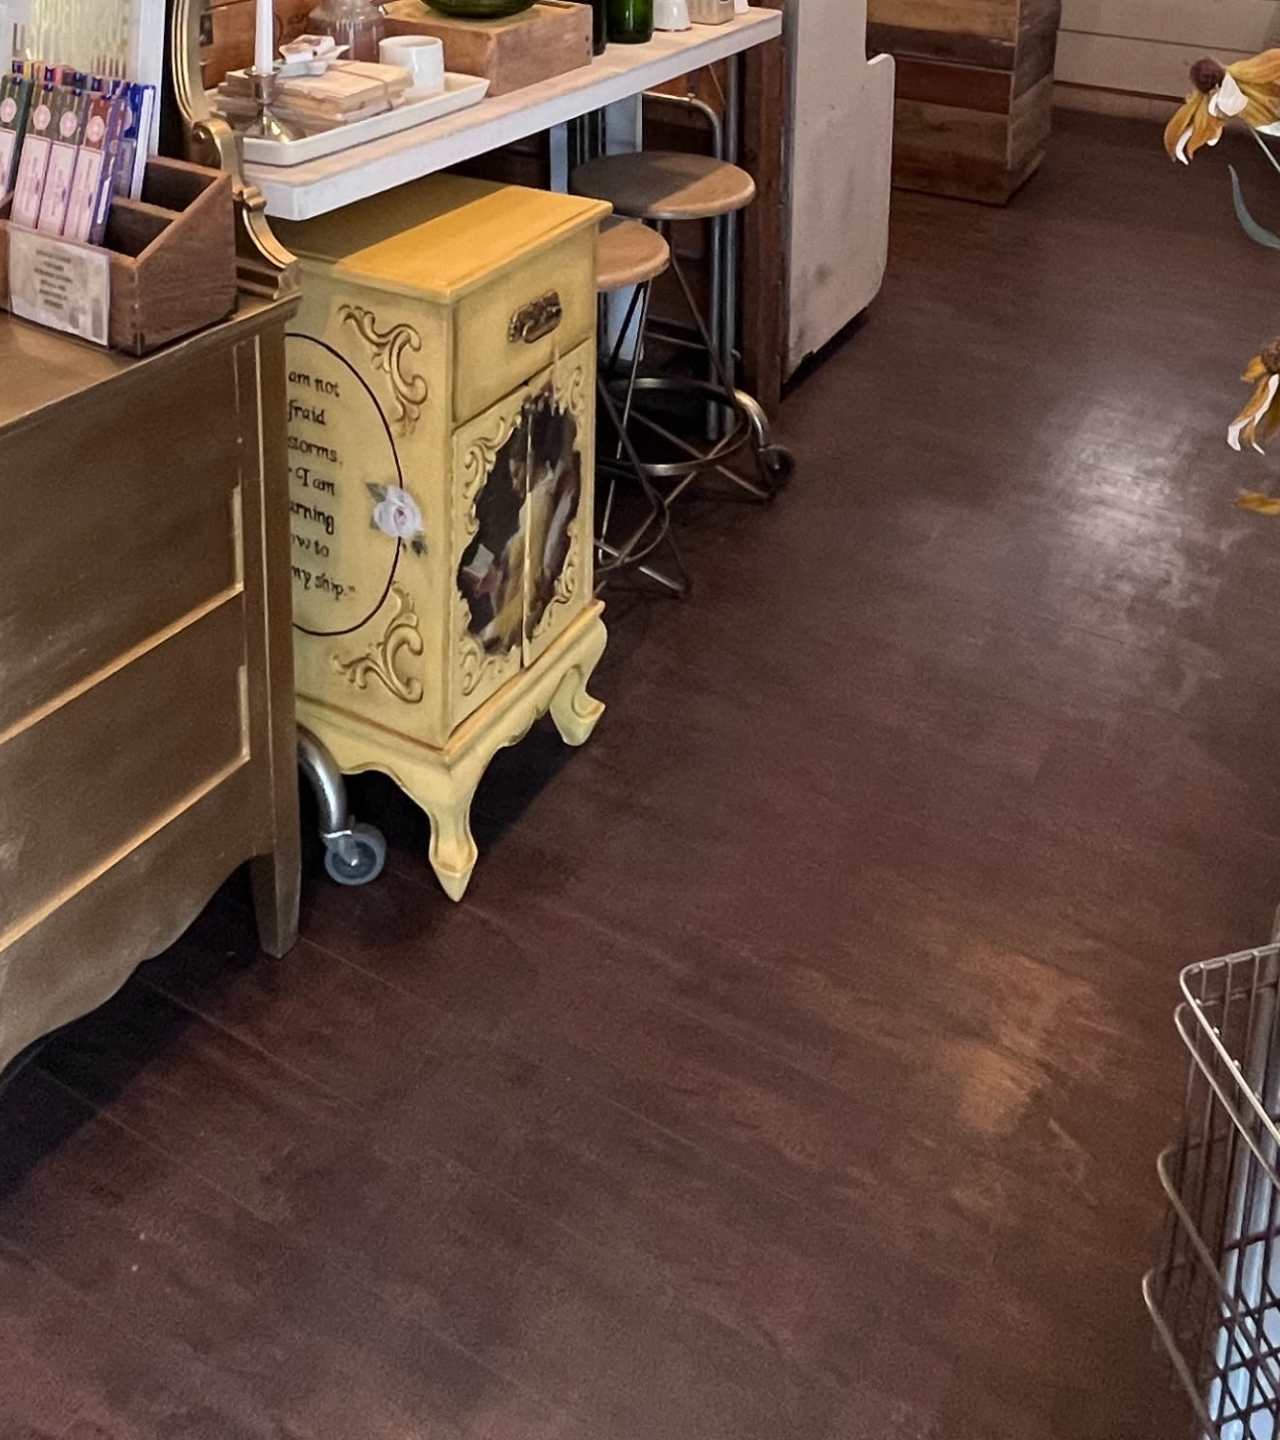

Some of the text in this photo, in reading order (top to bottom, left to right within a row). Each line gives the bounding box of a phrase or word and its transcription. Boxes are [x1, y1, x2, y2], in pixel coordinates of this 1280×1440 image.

[315, 377, 340, 398] not
[287, 399, 326, 426] fraid
[312, 478, 335, 496] am
[314, 539, 330, 558] to
